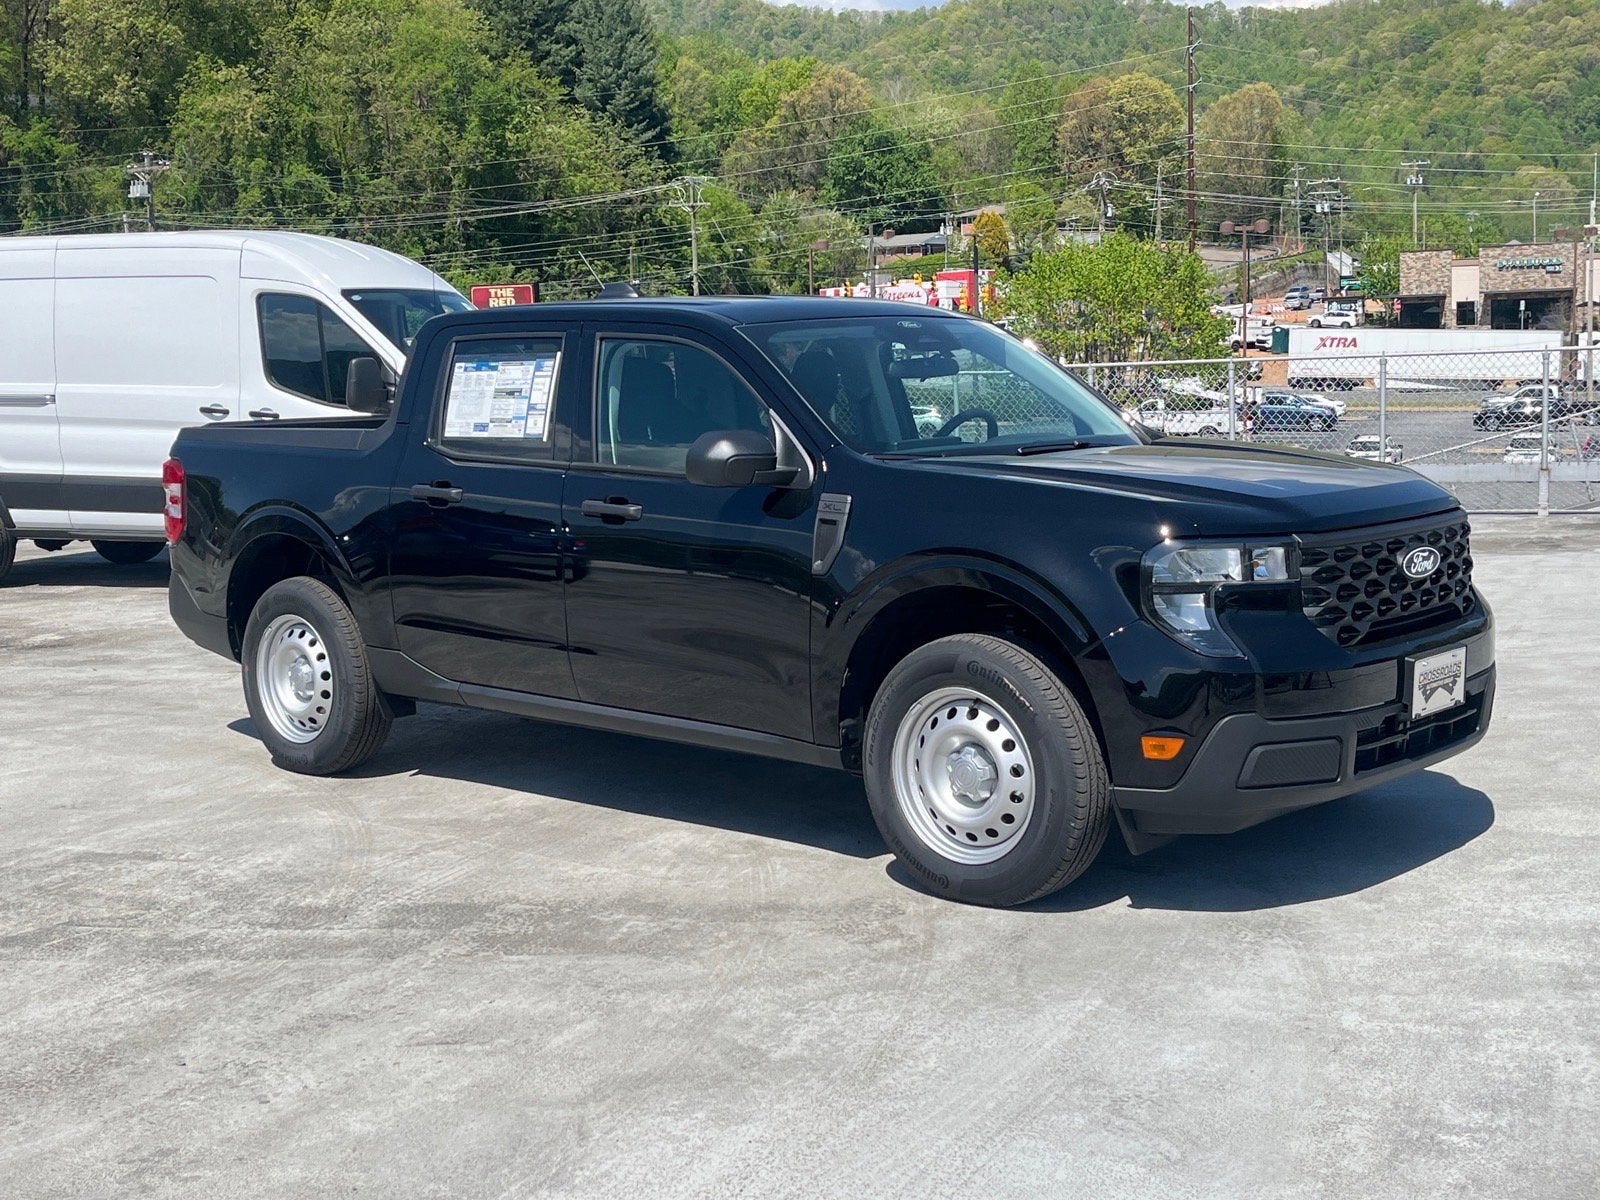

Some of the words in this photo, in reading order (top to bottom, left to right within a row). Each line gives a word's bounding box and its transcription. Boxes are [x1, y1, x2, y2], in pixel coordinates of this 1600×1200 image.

[489, 288, 515, 298] THE
[489, 297, 516, 308] RED
[1313, 336, 1358, 351] XTRA
[822, 502, 842, 511] XL
[1418, 661, 1462, 685] CROSSROADS
